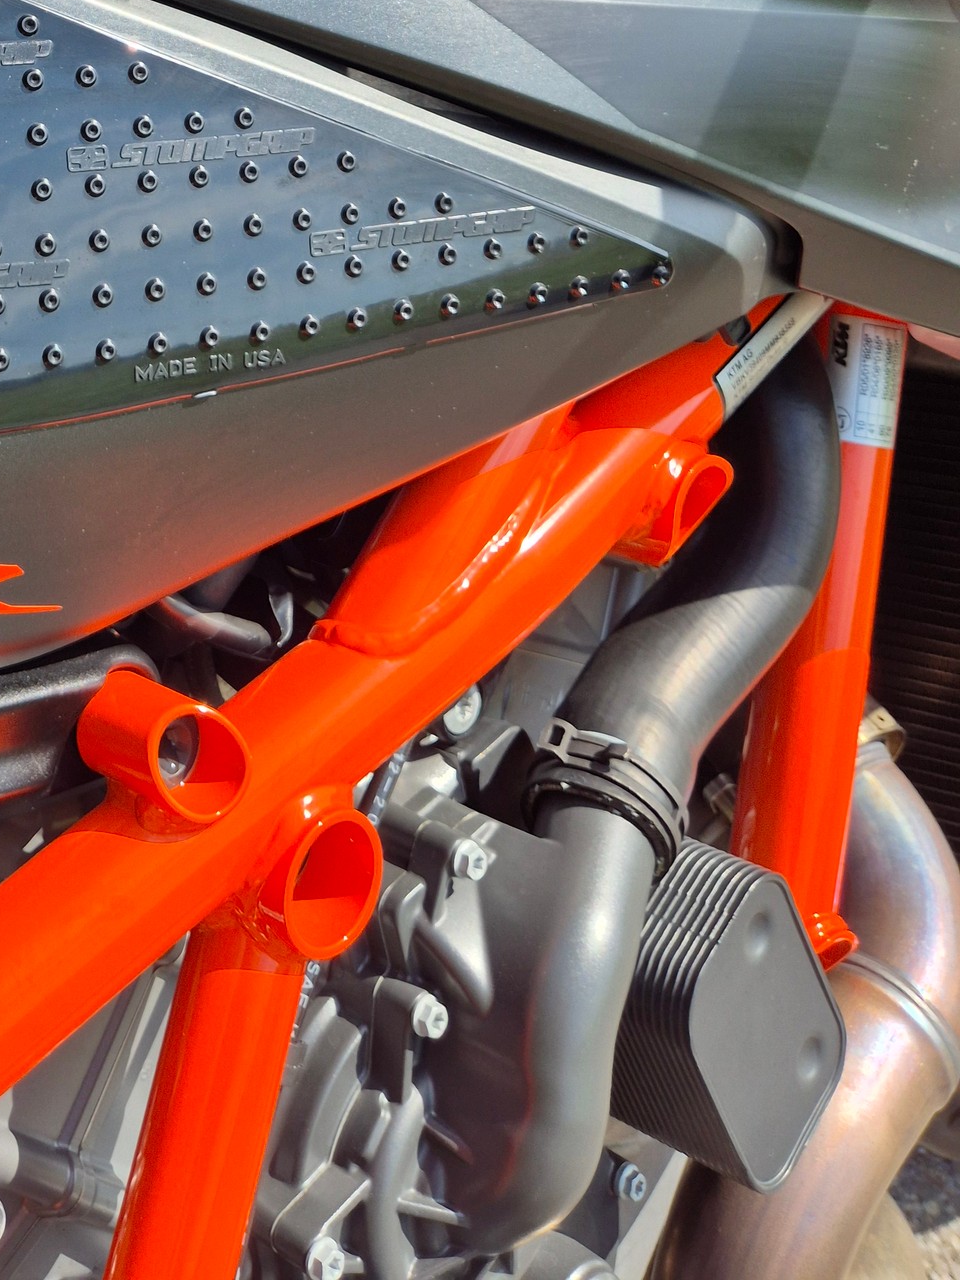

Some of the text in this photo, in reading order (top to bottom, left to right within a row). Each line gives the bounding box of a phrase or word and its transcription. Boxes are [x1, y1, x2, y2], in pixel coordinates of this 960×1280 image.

[110, 127, 316, 168] STOMPGRIP
[350, 205, 537, 251] STOMPGRIP
[726, 348, 753, 380] KTM AG
[834, 322, 850, 367] KTM
[134, 348, 286, 383] MADE IN USA
